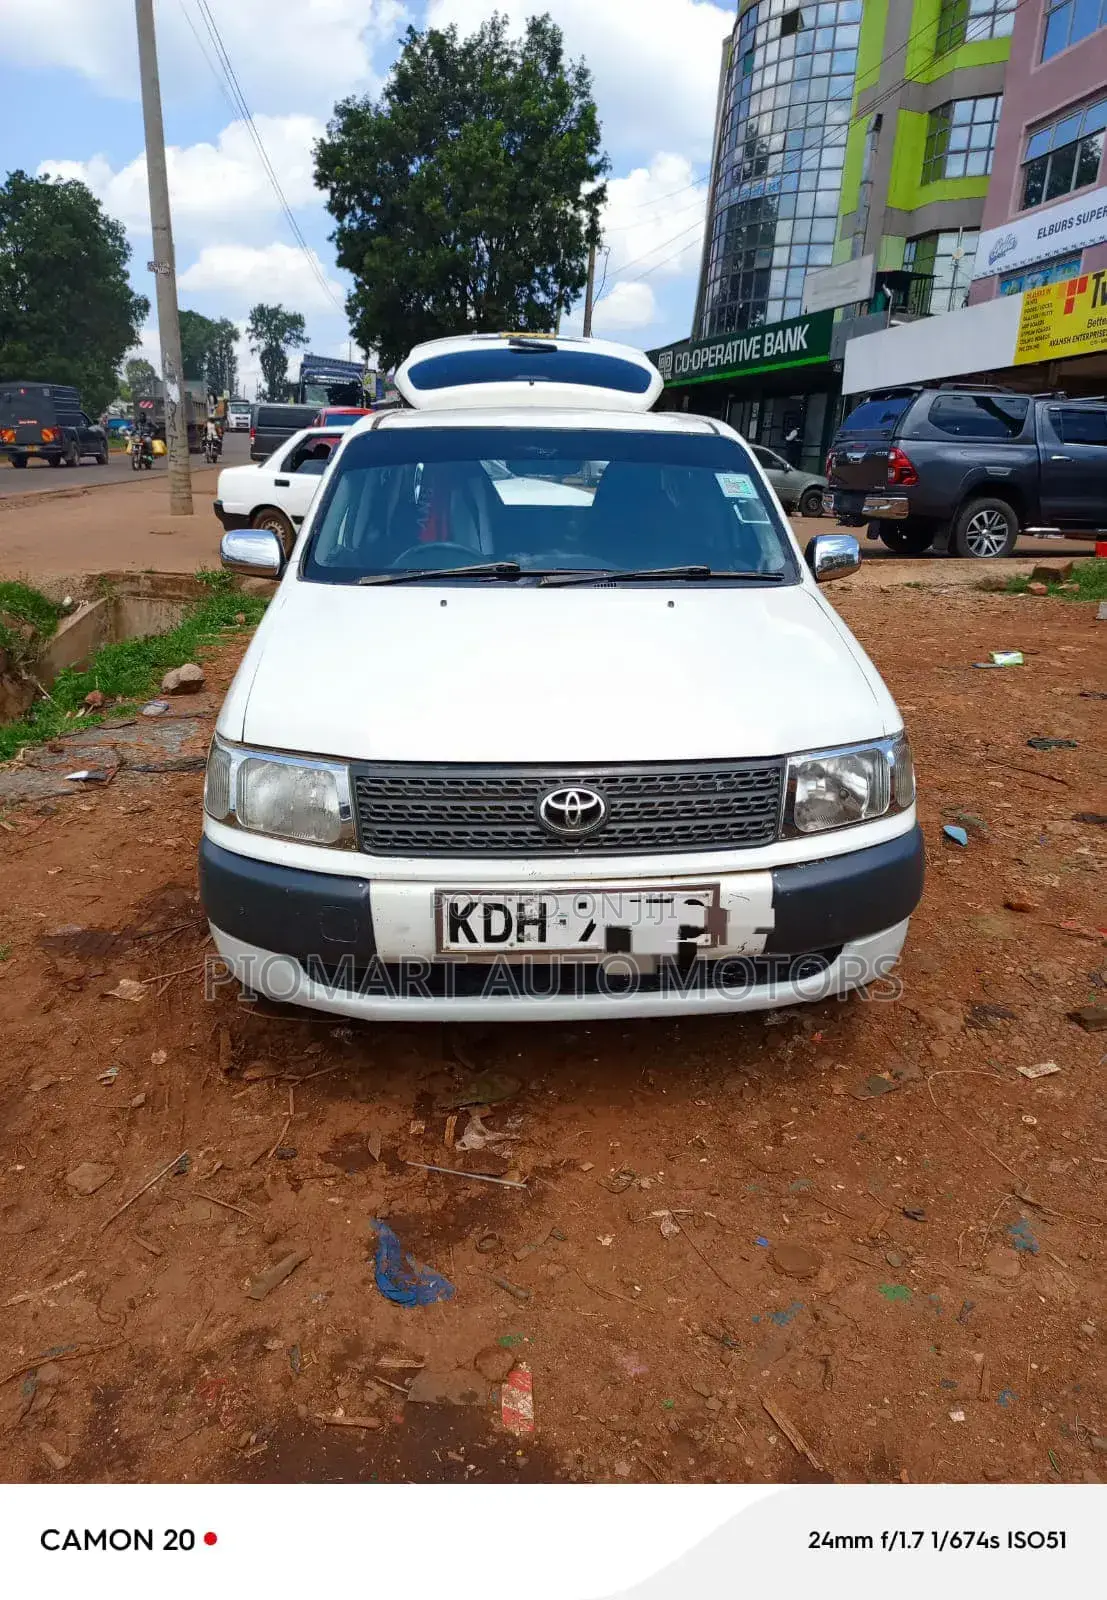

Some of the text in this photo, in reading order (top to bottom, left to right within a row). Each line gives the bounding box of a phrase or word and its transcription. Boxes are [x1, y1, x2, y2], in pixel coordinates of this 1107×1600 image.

[1037, 217, 1074, 240] ELBURS
[674, 323, 810, 374] CO-OPERATIVE BANK
[449, 902, 547, 944] KDH
